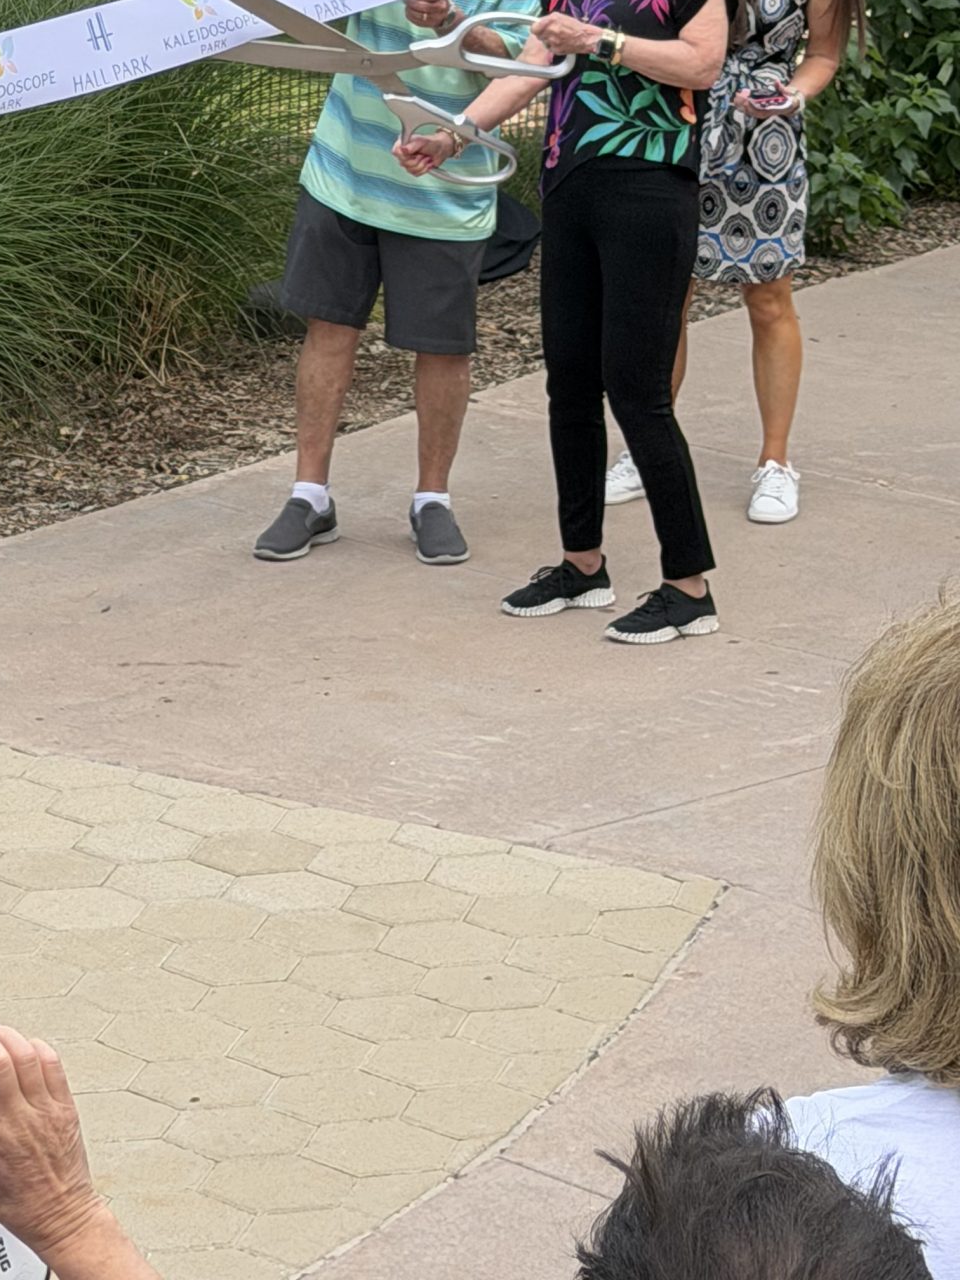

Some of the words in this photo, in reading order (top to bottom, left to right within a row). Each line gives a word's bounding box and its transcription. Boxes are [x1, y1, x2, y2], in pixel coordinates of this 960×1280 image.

[162, 13, 260, 51] KALEIDOSCOPE
[200, 38, 229, 55] PARK
[72, 68, 112, 94] HALL
[112, 54, 153, 81] PARK
